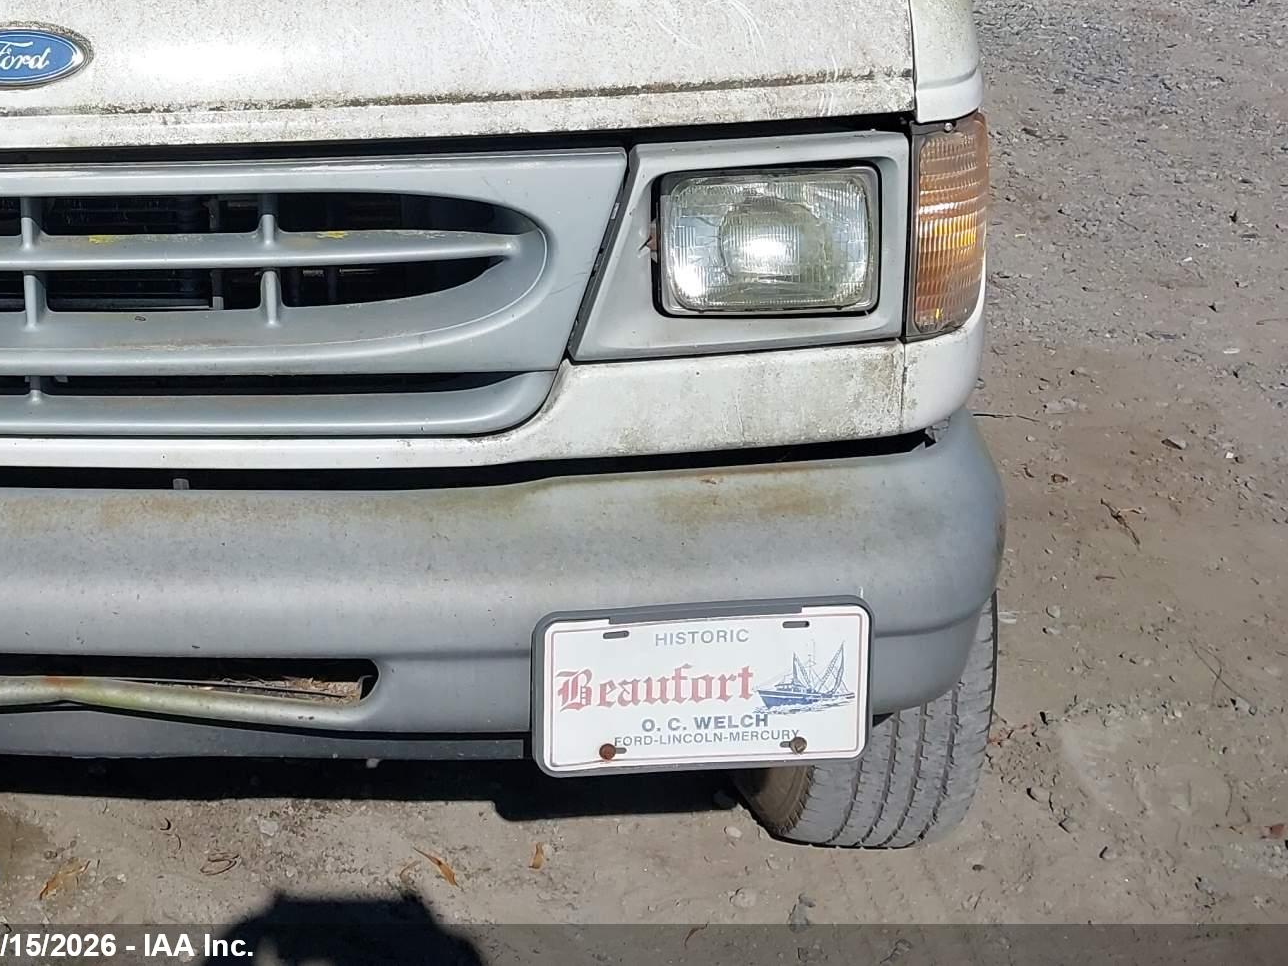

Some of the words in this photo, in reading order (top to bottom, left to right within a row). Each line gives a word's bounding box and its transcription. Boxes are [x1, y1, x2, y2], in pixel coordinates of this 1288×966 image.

[654, 628, 750, 647] HISTORIC
[554, 662, 754, 713] Beaufort
[641, 718, 662, 733] O.
[667, 716, 688, 732] C.
[693, 713, 770, 731] WELCH
[614, 728, 800, 748] FORD-LINCOLN-MERCURY
